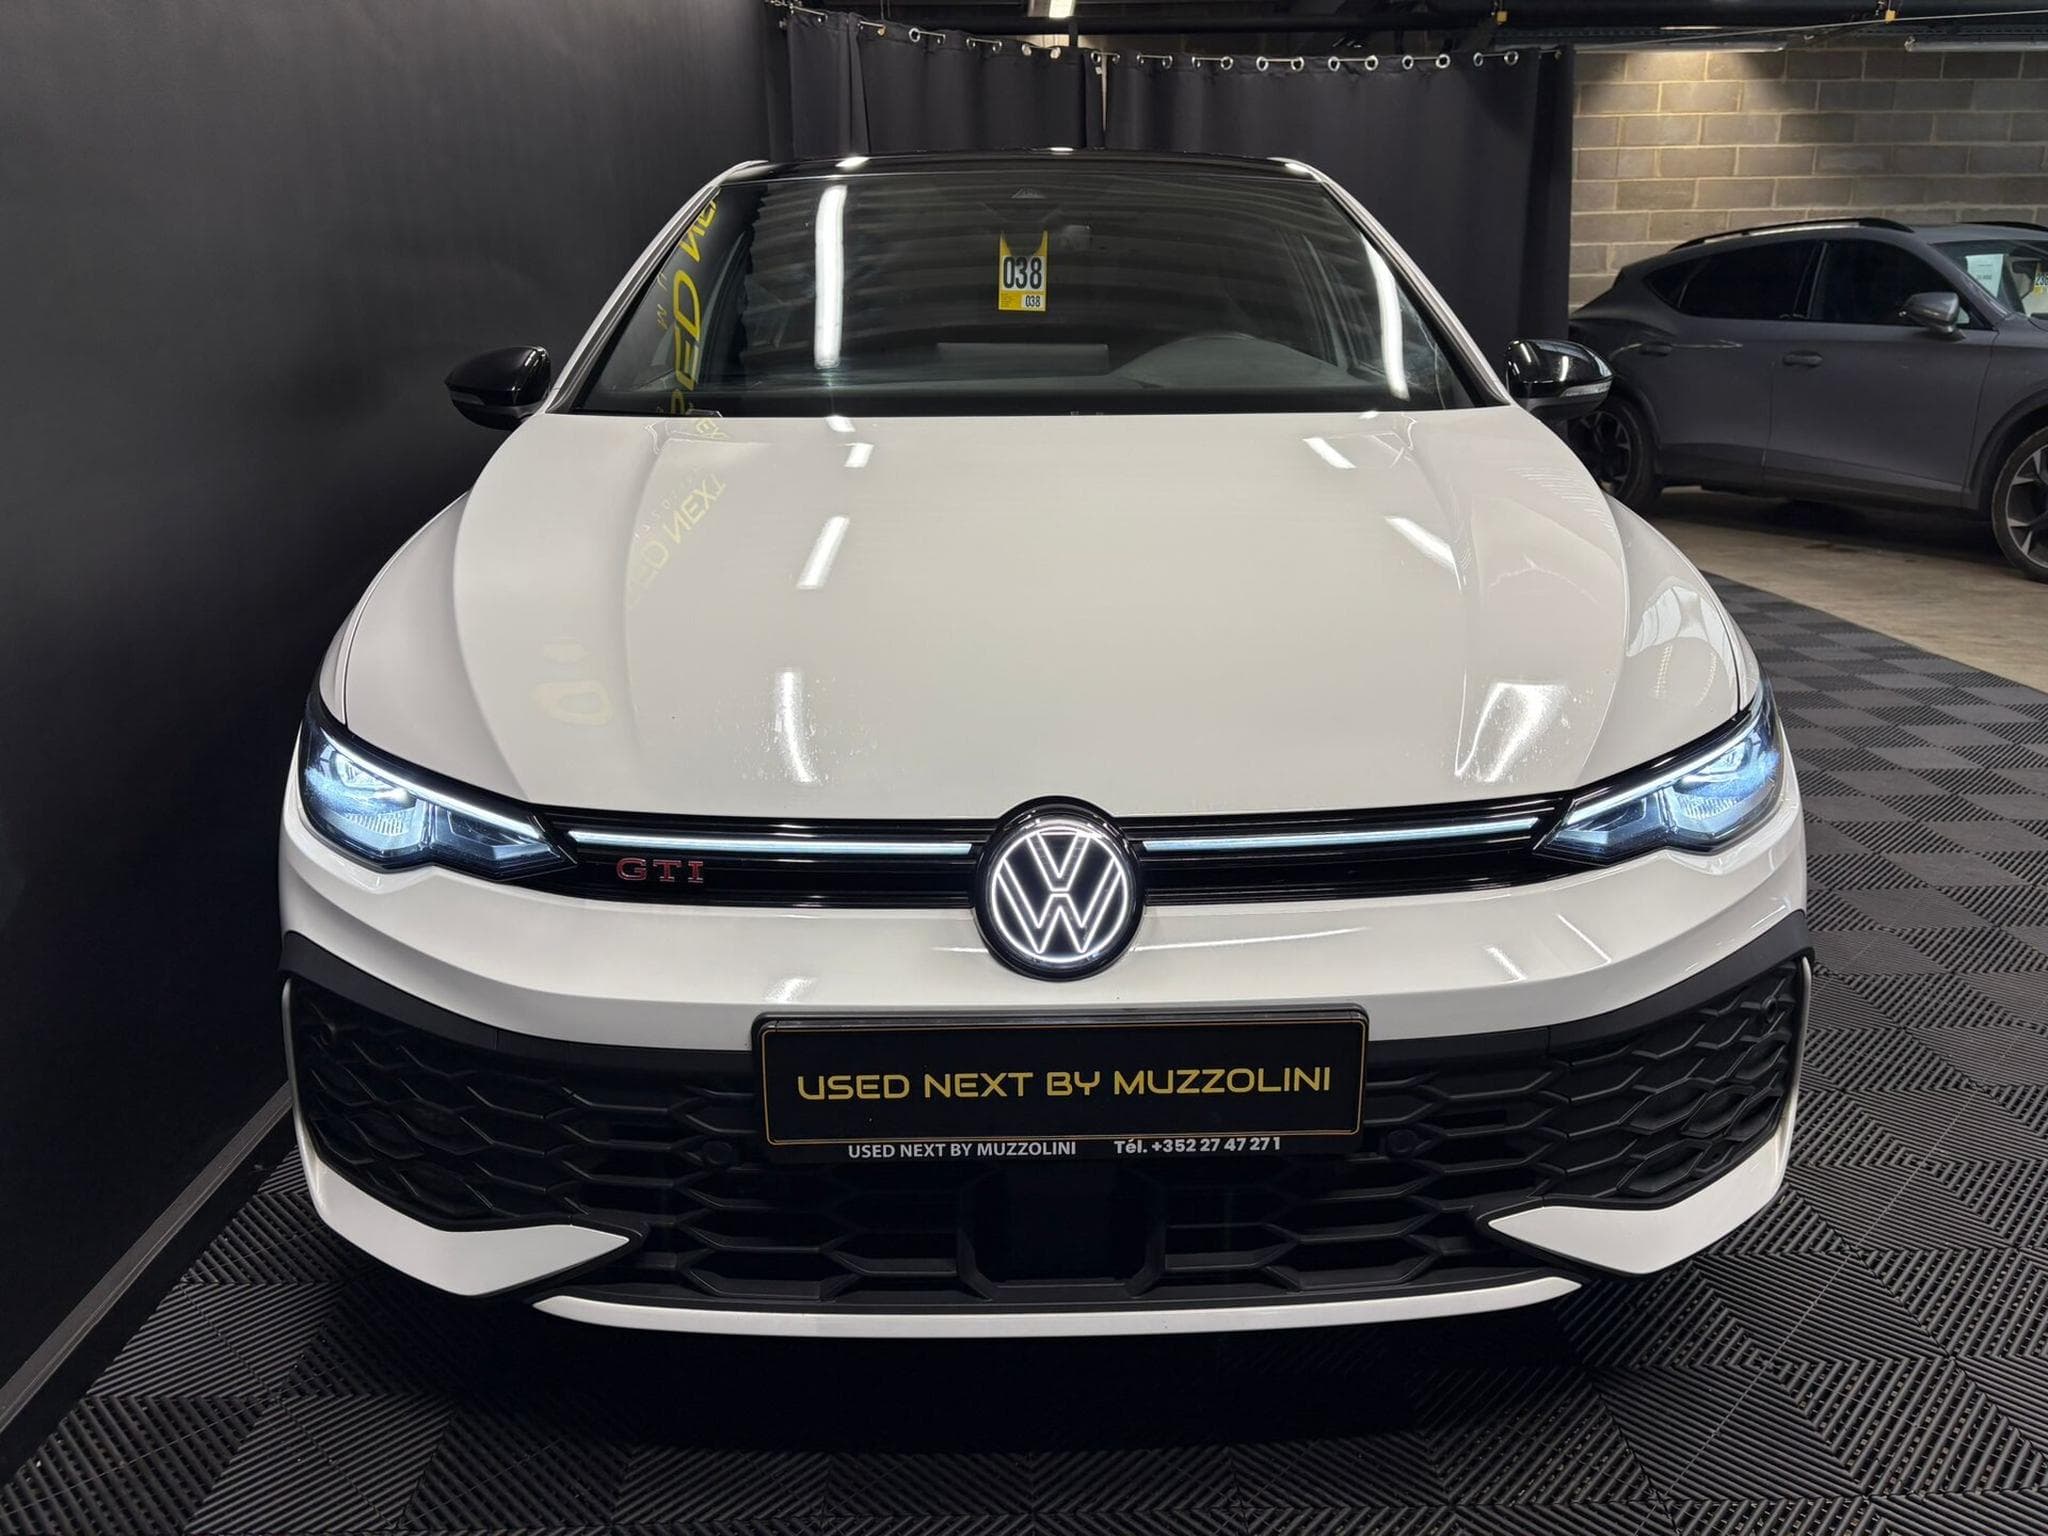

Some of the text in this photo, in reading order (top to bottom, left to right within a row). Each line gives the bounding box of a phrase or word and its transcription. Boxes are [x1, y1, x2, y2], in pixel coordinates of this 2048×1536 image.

[1003, 256, 1042, 289] 038
[1025, 295, 1041, 308] 038
[616, 857, 704, 884] GTI
[992, 828, 1127, 962] VW
[798, 1067, 1332, 1100] USED NEXT BY MUZZOLINI
[848, 1140, 1077, 1159] USED NEXT BY MUZZOLINI
[1114, 1138, 1148, 1154] Tél.
[1151, 1139, 1197, 1153] +352
[1200, 1138, 1222, 1152] 27
[1223, 1137, 1247, 1152] 47
